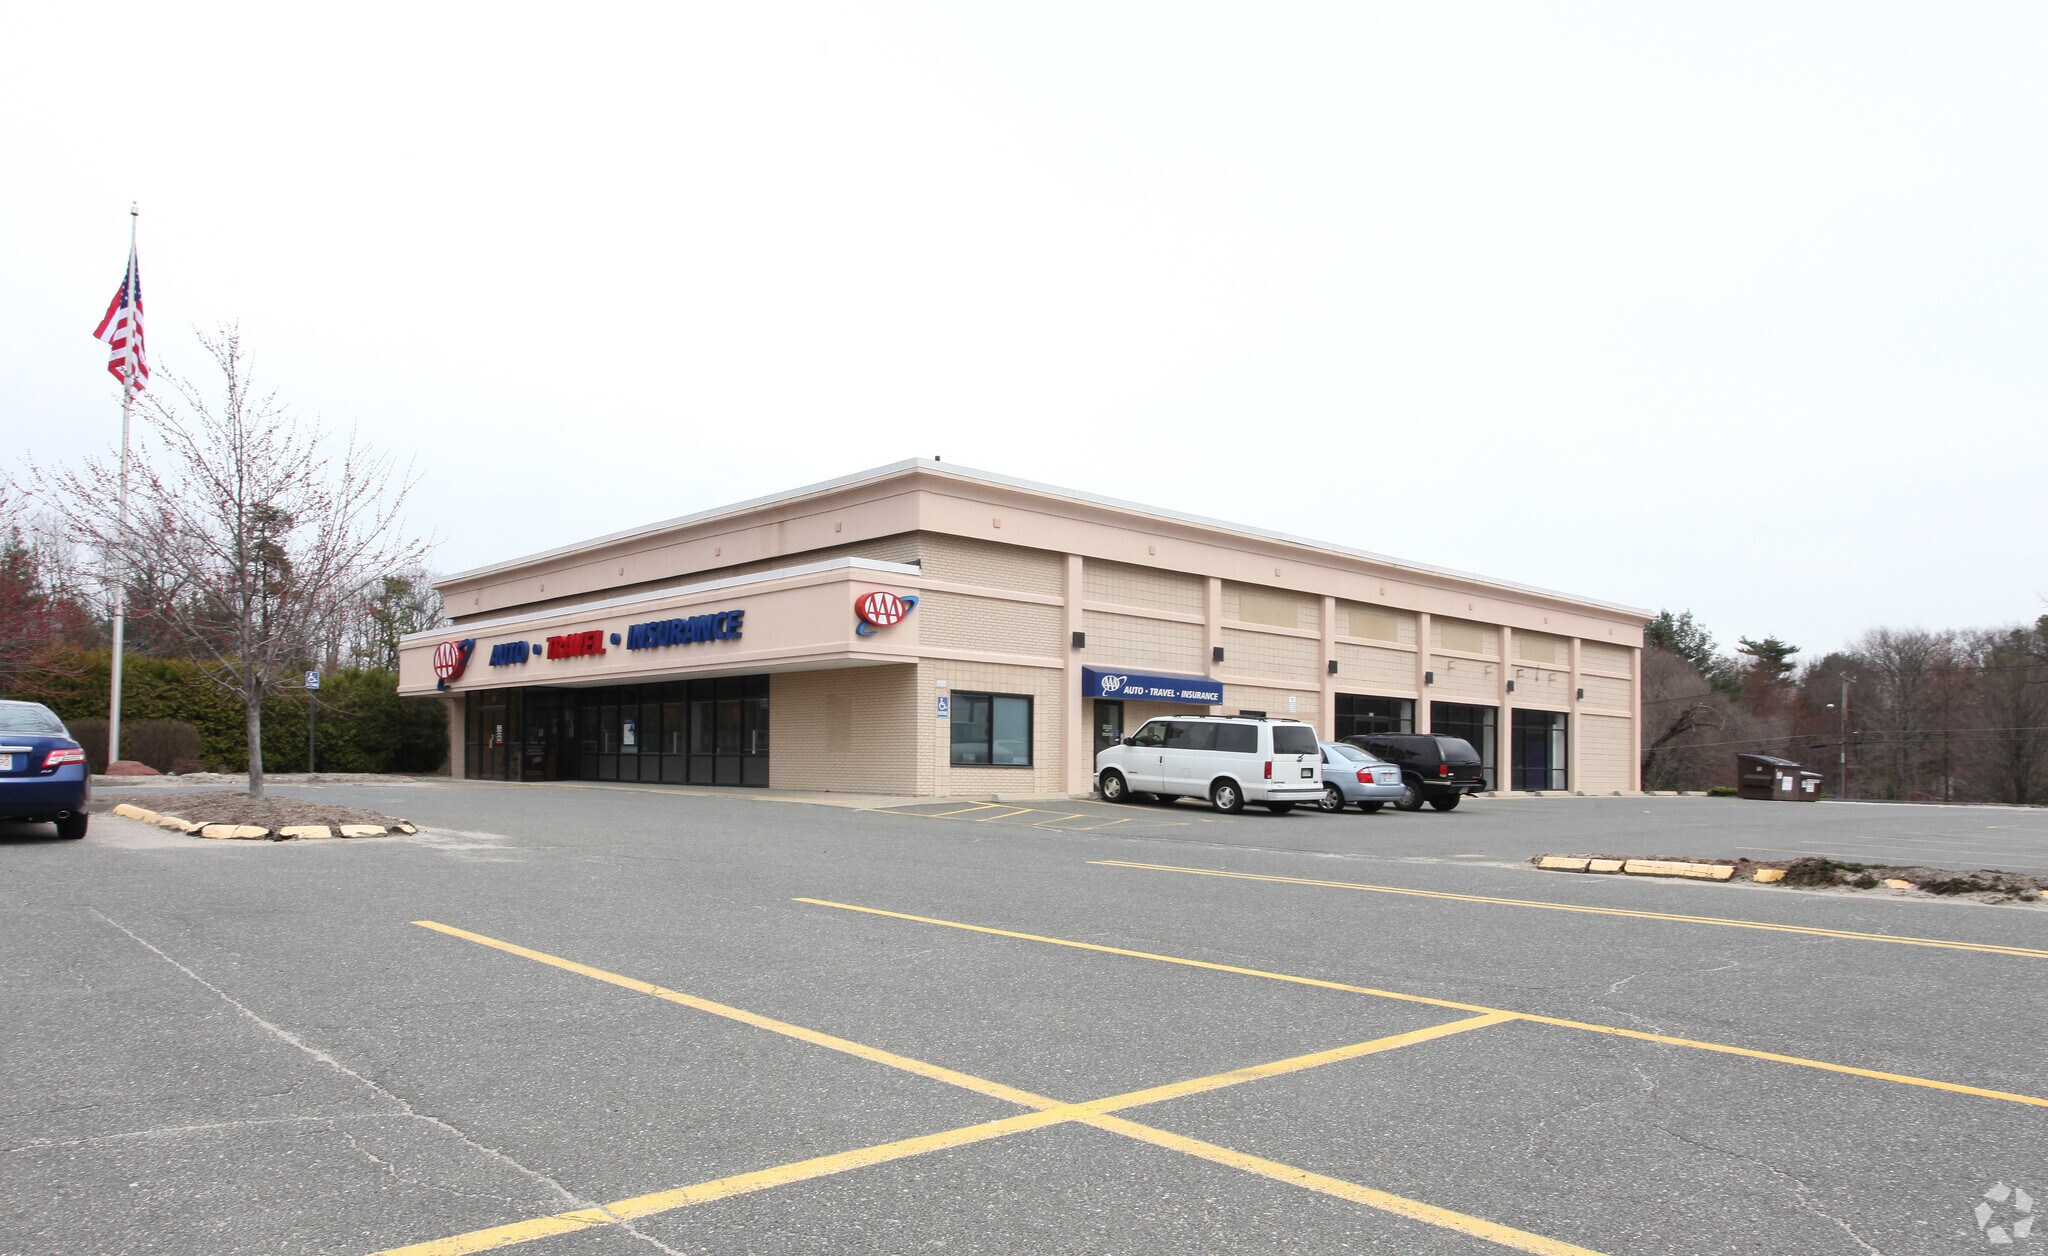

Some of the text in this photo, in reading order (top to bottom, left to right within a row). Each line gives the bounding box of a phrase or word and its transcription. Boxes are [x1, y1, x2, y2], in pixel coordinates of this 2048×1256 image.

[862, 592, 906, 626] AAA
[489, 609, 745, 667] AUTO TRAVEL INSURANCE
[434, 642, 458, 680] AAA
[1101, 675, 1120, 692] AAA
[1123, 686, 1219, 701] AUTO TRAVEL INSURANCE
